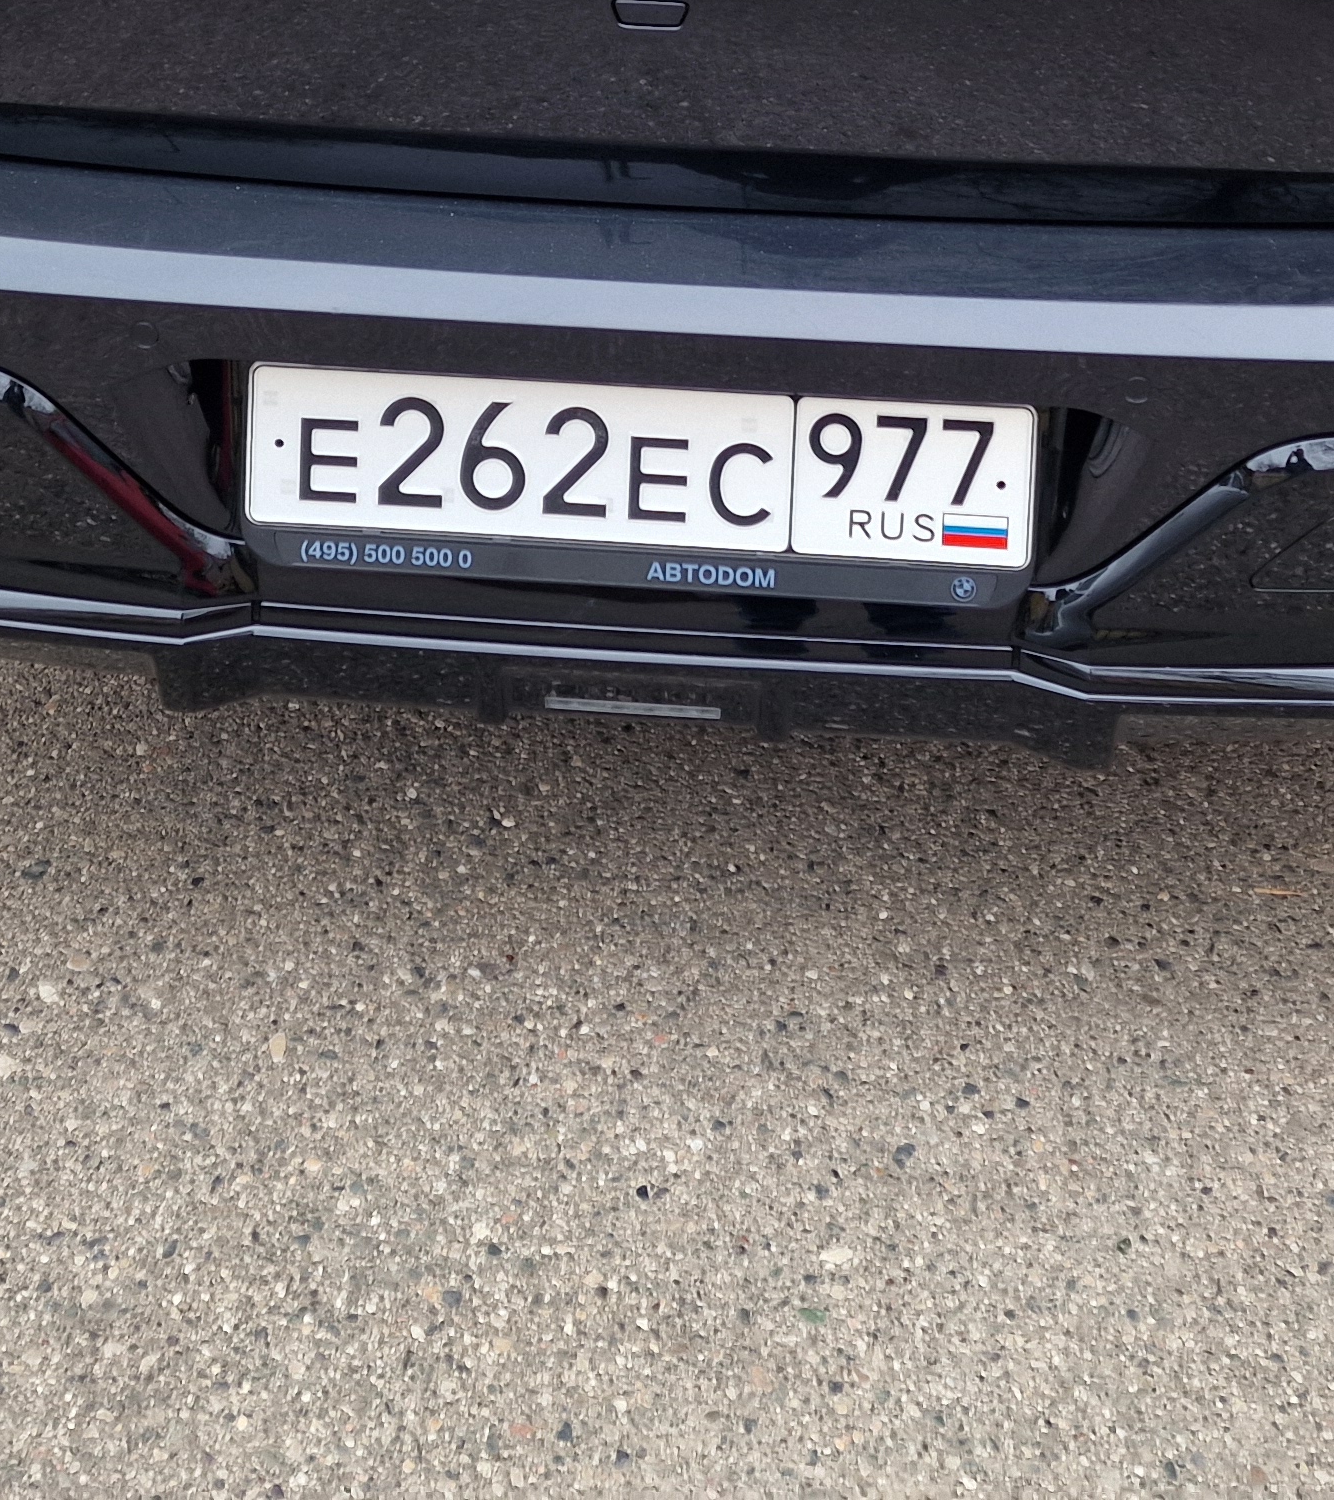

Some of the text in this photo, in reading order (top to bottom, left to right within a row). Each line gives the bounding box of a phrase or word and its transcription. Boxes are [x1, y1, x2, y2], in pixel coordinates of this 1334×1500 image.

[299, 396, 995, 527] E262EC 977
[848, 508, 935, 543] RUS
[301, 539, 472, 569] (495) 500 500 0
